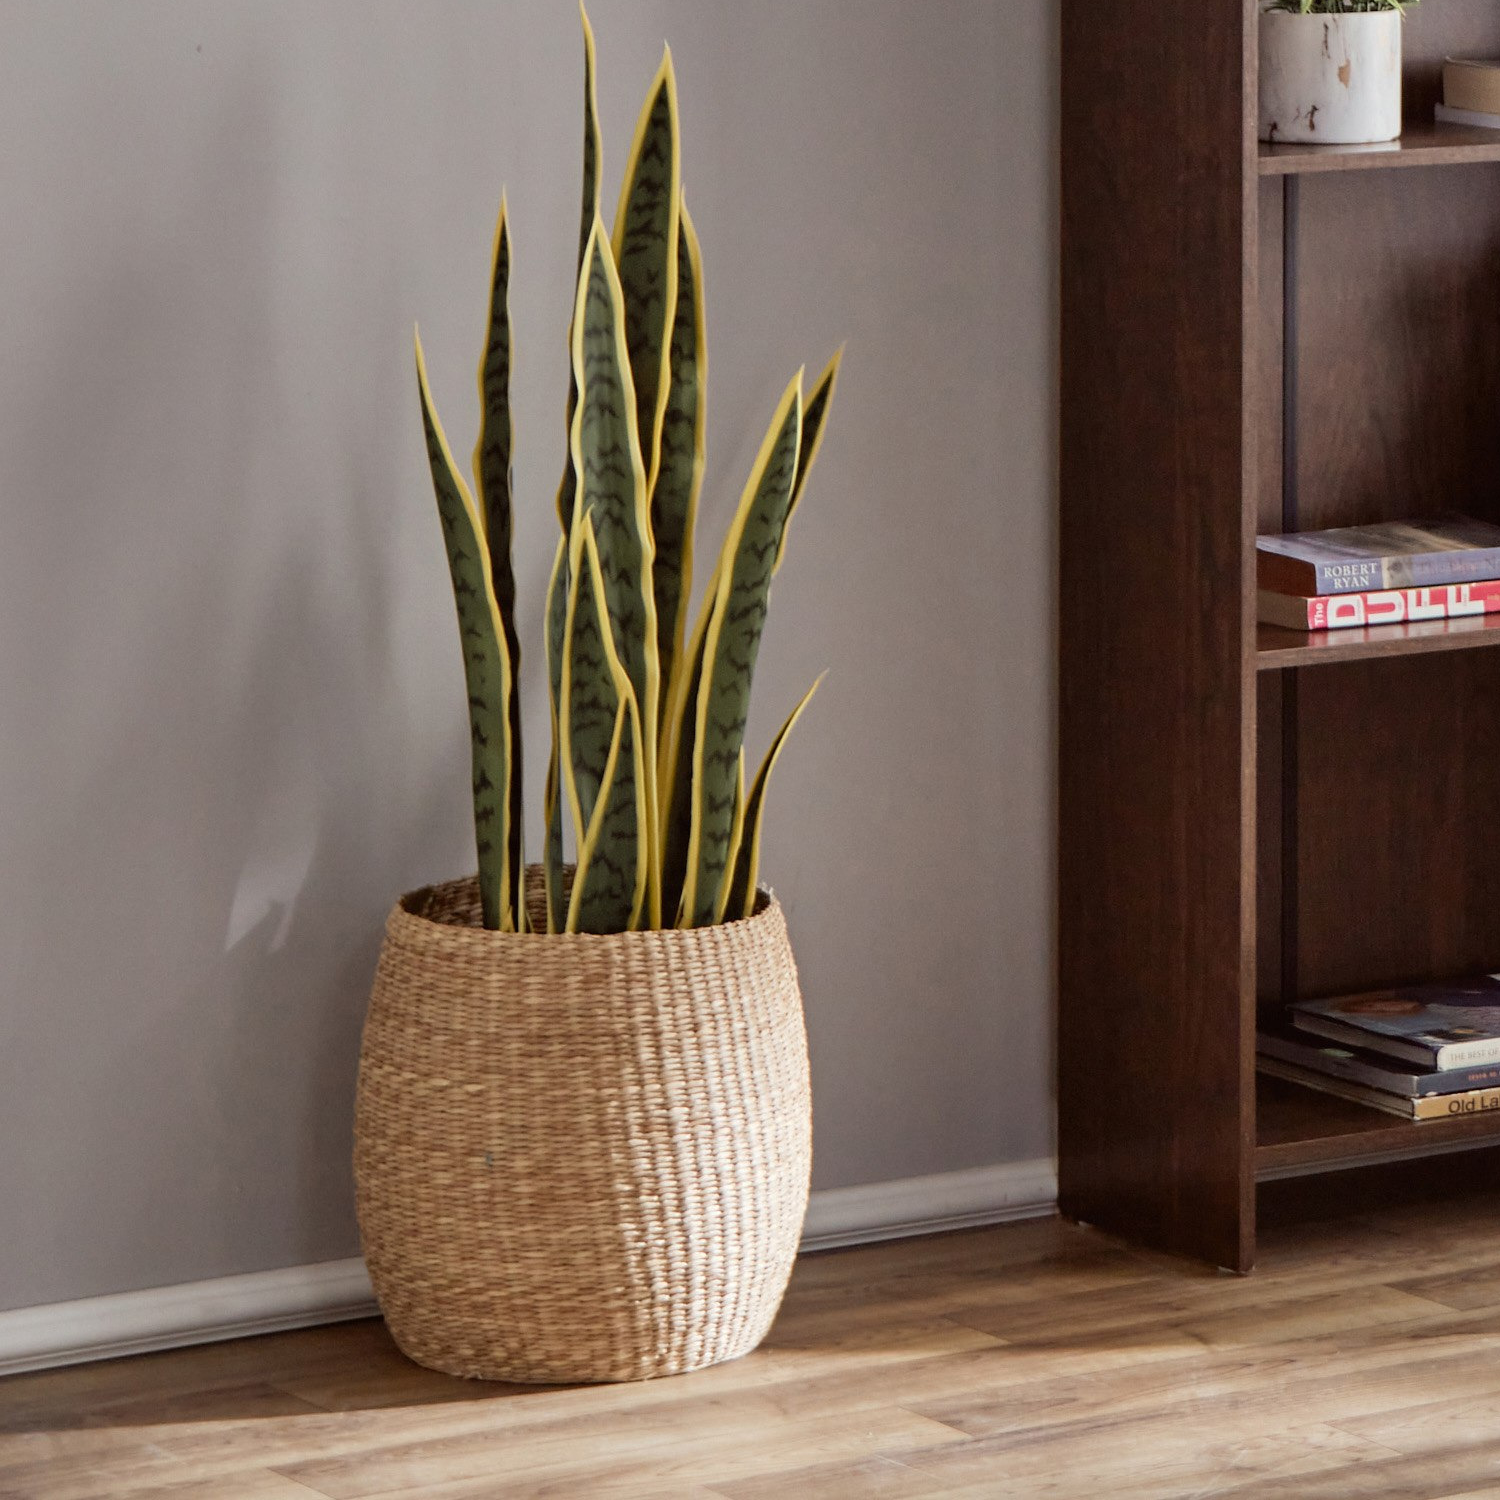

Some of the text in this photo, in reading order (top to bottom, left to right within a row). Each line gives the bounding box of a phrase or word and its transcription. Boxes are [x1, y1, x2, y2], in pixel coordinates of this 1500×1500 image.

[1324, 562, 1378, 579] ROBERT
[1333, 575, 1370, 590] RYAN
[1313, 583, 1485, 628] The DUFF
[1449, 1048, 1466, 1061] THE
[1467, 1046, 1487, 1059] BEST
[1448, 1096, 1476, 1115] Old
